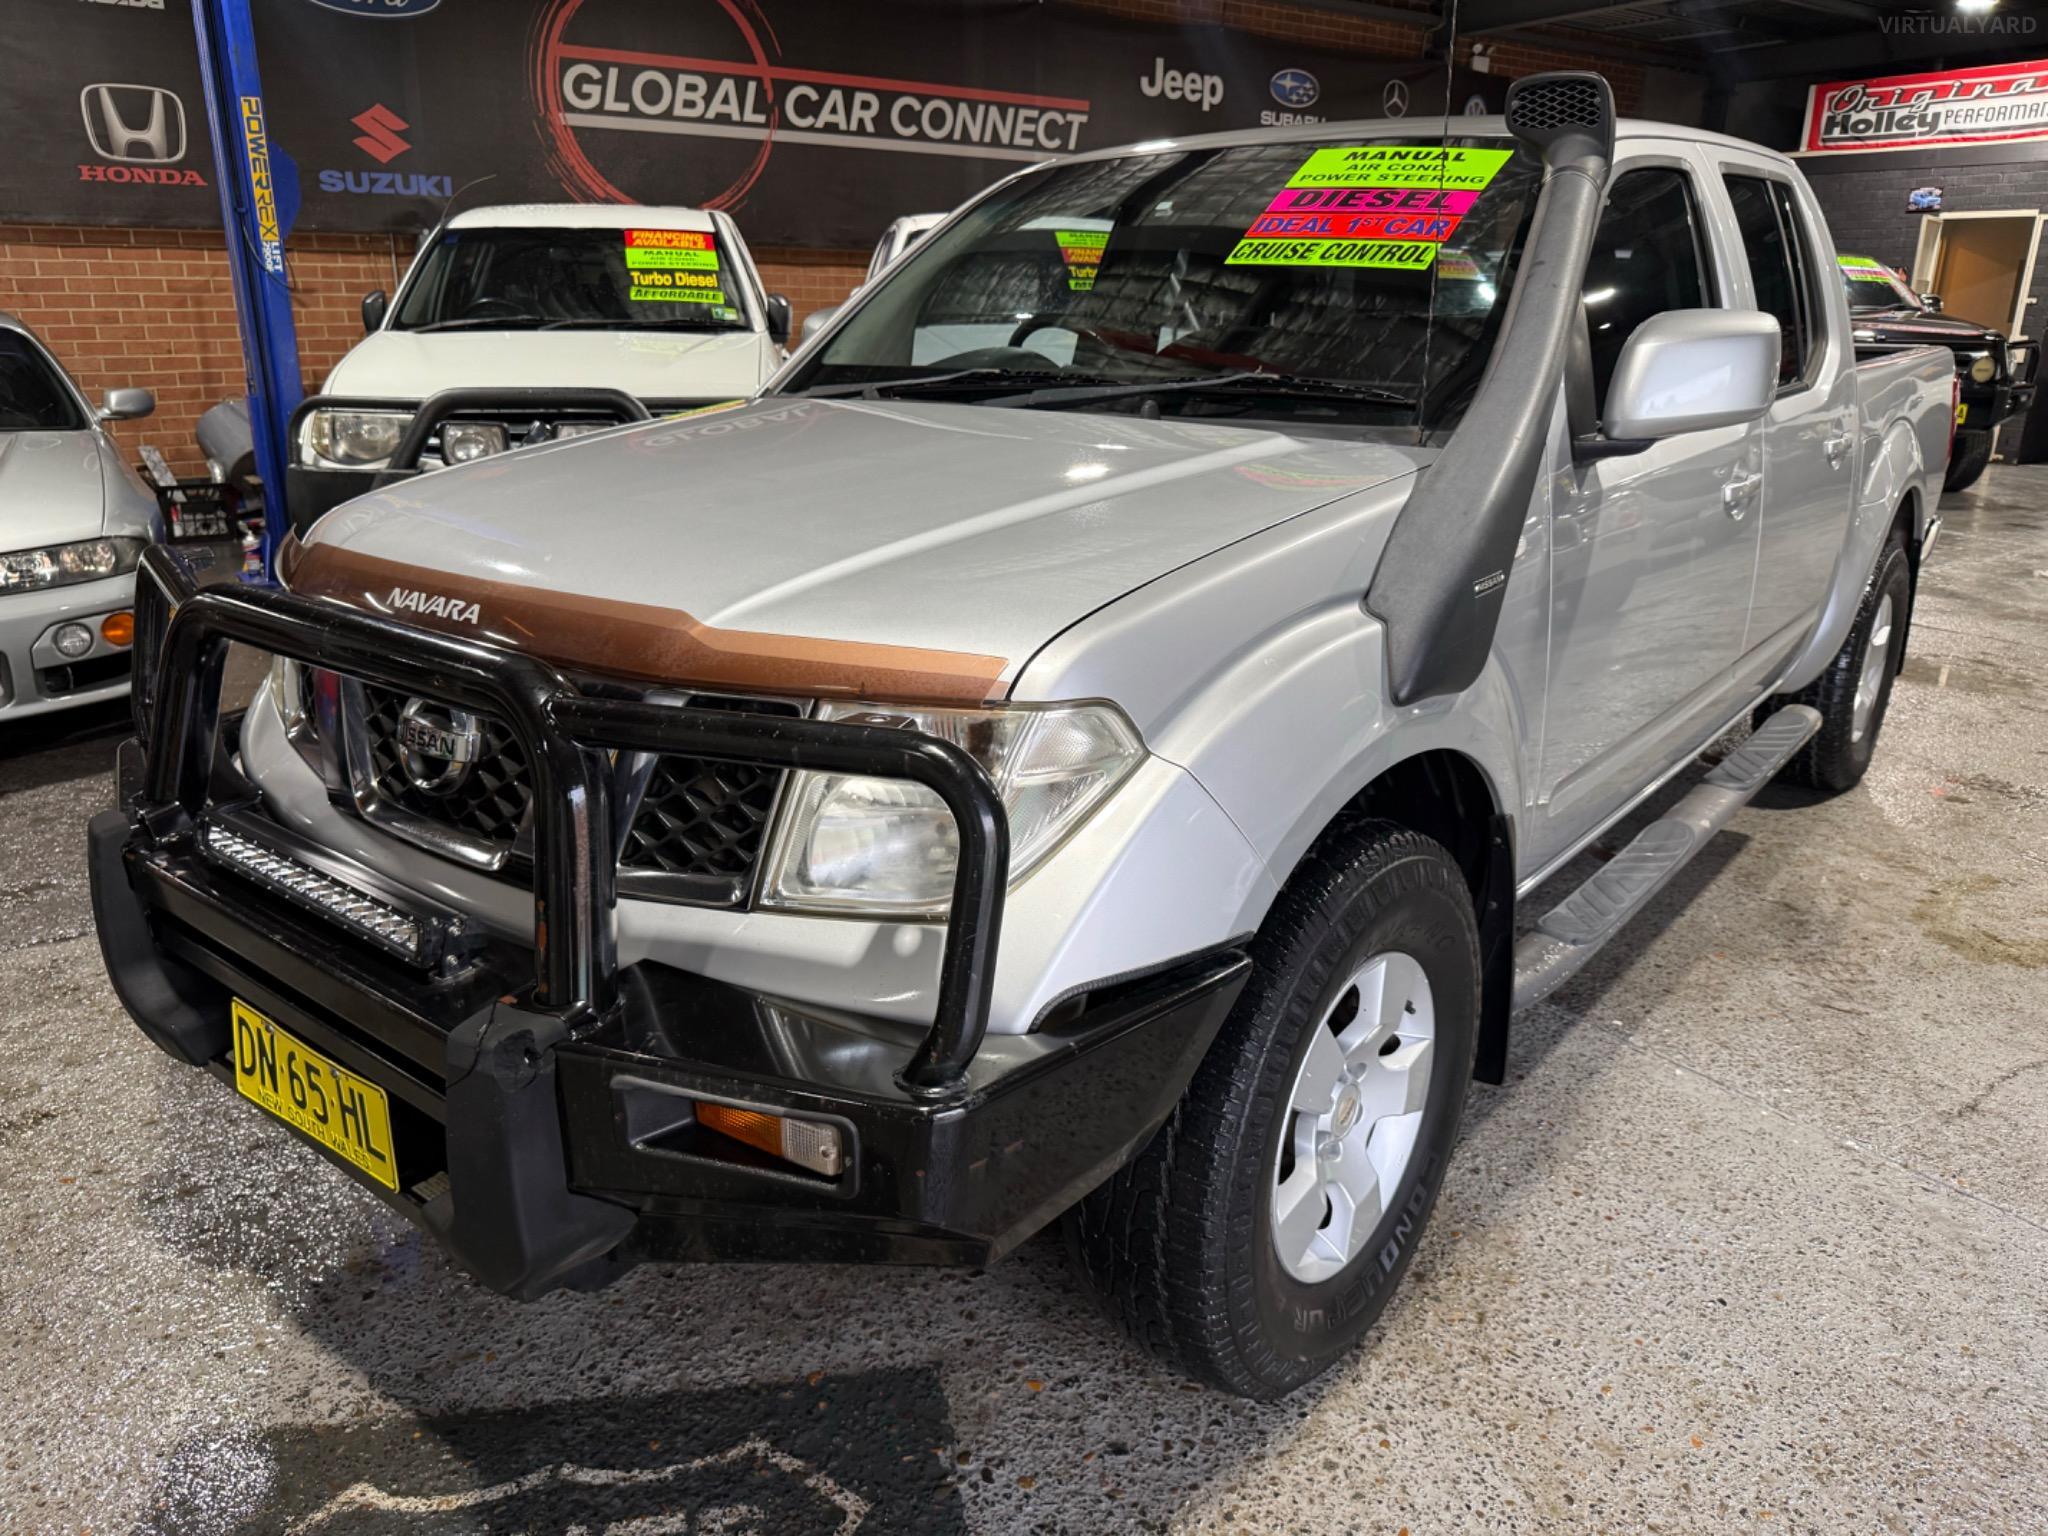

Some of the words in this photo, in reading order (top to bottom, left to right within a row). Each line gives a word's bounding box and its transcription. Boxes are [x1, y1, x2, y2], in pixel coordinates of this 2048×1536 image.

[1140, 58, 1223, 111] Jeep
[562, 64, 767, 124] GLOBAL
[784, 86, 880, 133] CAR
[890, 96, 1088, 150] CONNECT
[1261, 111, 1326, 126] SUBAR
[1822, 110, 1941, 138] Holley
[1344, 151, 1466, 162] MANUAL
[78, 165, 208, 186] HONDA
[243, 97, 279, 239] POWERREX
[1346, 163, 1381, 171] AIR
[319, 169, 453, 197] SUZUKI
[1300, 174, 1371, 182] POWER
[1377, 174, 1485, 185] STEERING
[1287, 190, 1452, 209] DIESEL
[632, 231, 705, 241] FINANCING
[1253, 216, 1333, 233] IDEAL
[1385, 218, 1450, 236] CAR
[632, 239, 707, 249] AVAILABLE
[1231, 243, 1314, 260] CRUISE
[1319, 243, 1431, 263] CONTROL
[630, 271, 672, 286] Turbo
[674, 272, 718, 288] Diesel
[634, 289, 720, 301] AFFORDABLE
[386, 587, 480, 624] NAVARA
[259, 1086, 283, 1113] NEW
[287, 1105, 327, 1140] SOUTH
[331, 1131, 372, 1171] WALES
